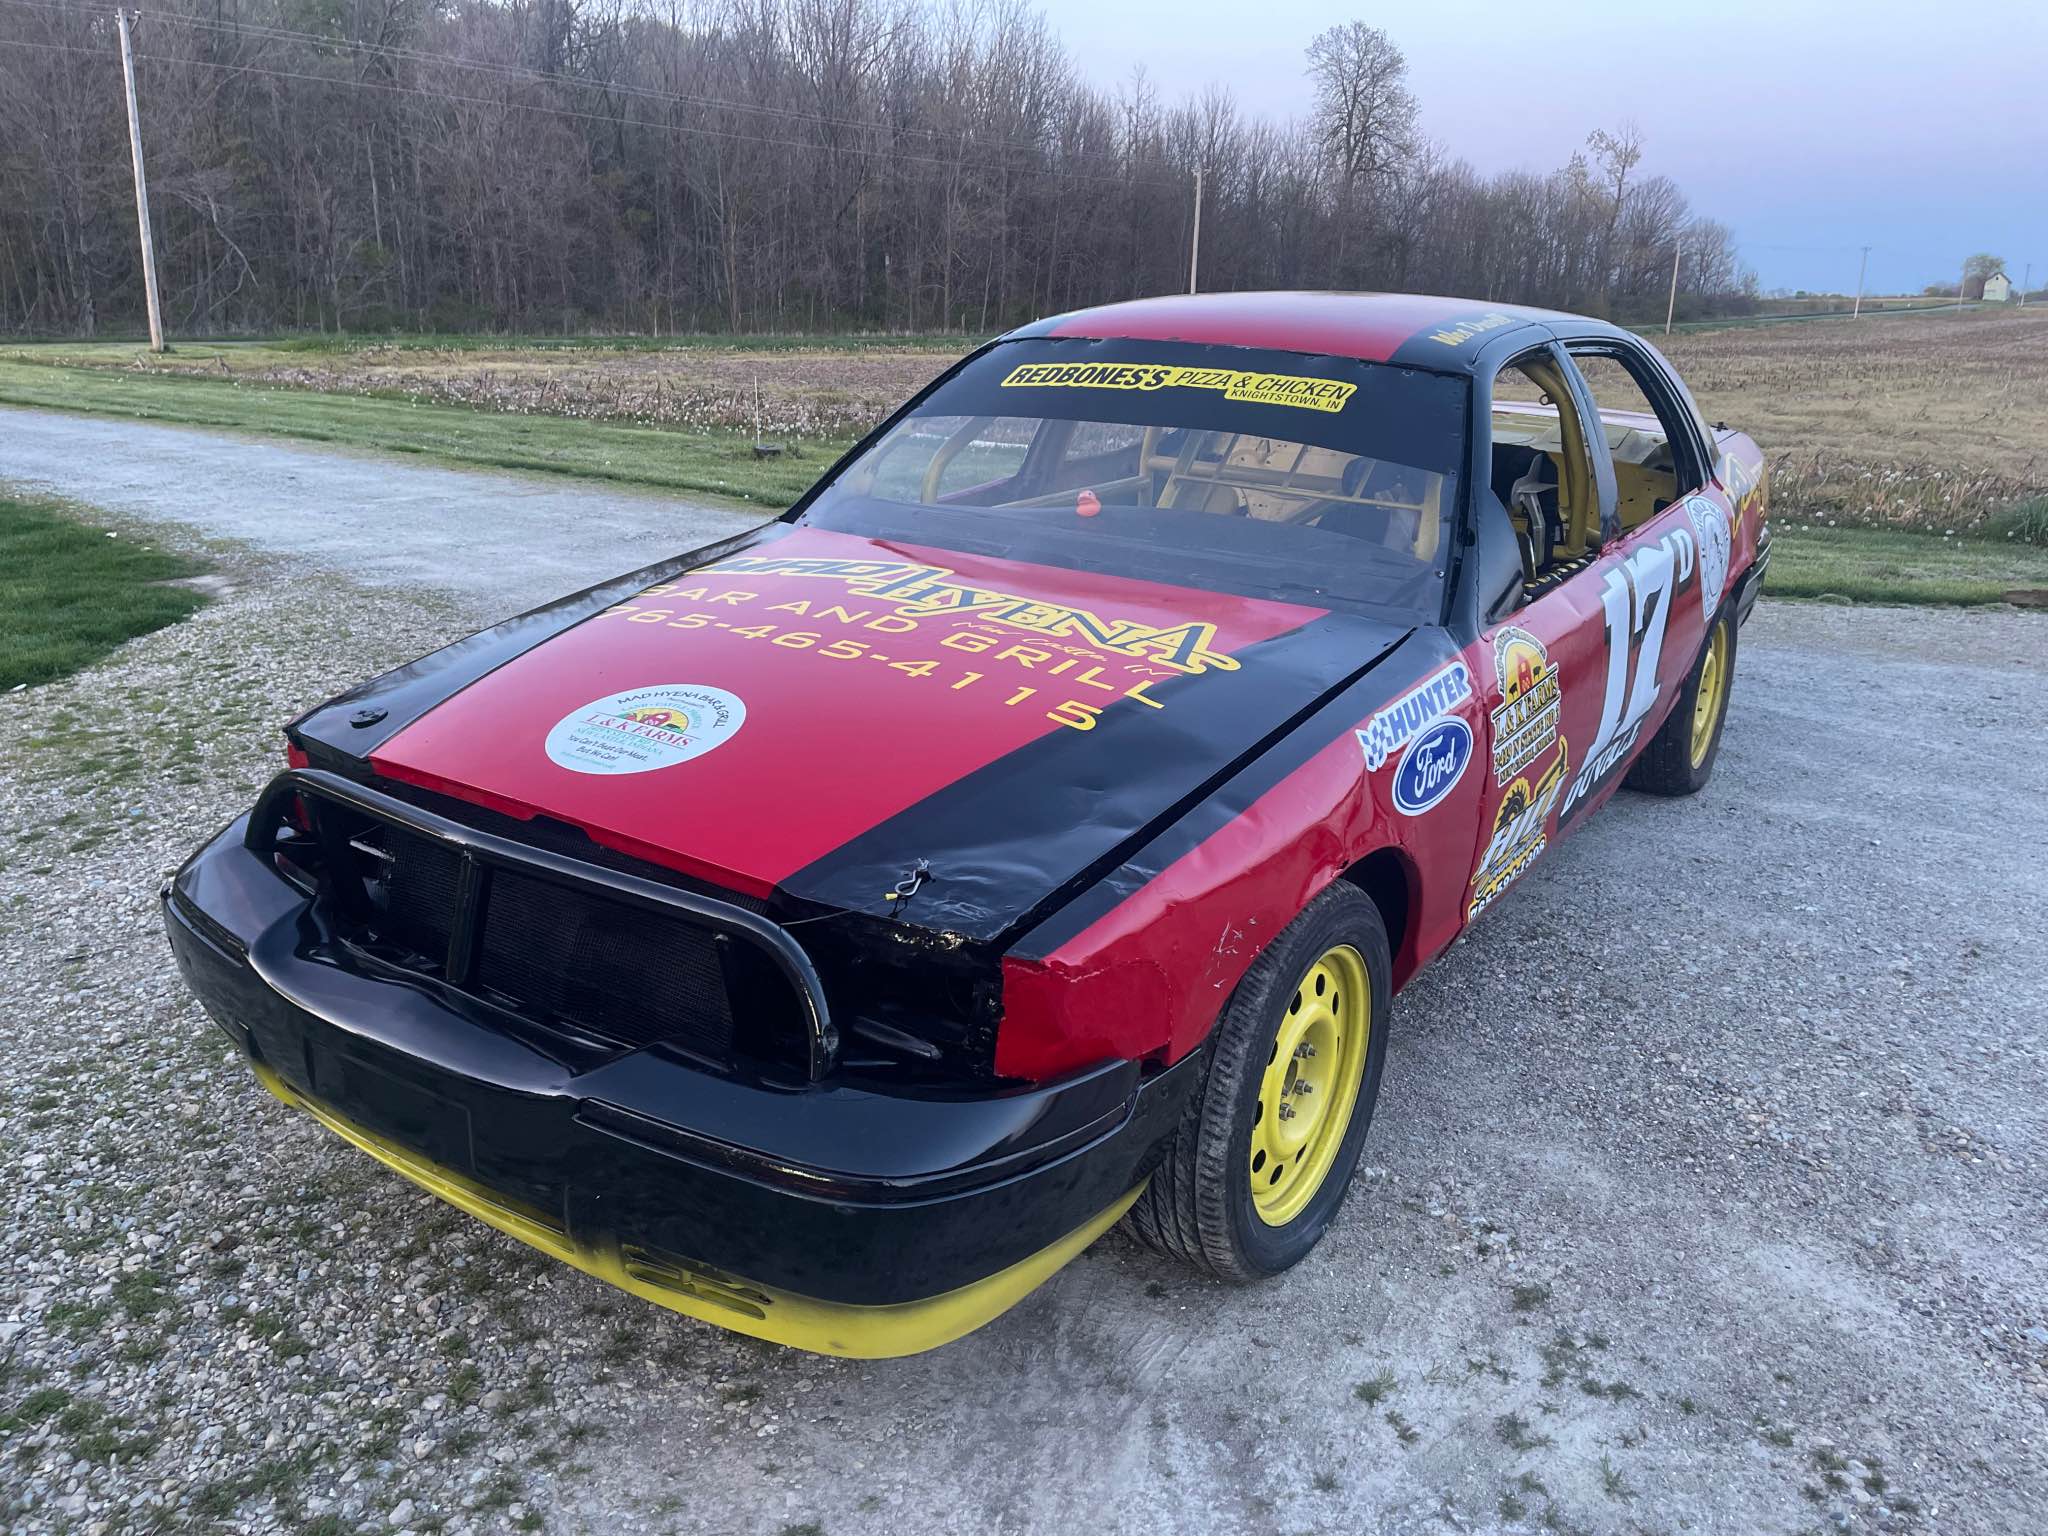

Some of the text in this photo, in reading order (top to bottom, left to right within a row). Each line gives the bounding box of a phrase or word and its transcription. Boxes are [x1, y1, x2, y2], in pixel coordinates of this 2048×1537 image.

[1007, 366, 1353, 400] REDBONES'S PIZZA & CHICKEN
[1231, 388, 1341, 410] KNIGHTSTOWN, IN
[845, 562, 1242, 676] HYENA
[593, 605, 1104, 732] 765-465-4115
[639, 584, 1166, 710] BAR AND GRILL
[1123, 664, 1184, 678] IN
[617, 692, 652, 705] MAD
[654, 690, 699, 698] HYENA
[1387, 667, 1470, 745] HUNTER
[600, 718, 615, 727] &
[631, 725, 690, 747] FARMS
[1414, 734, 1457, 798] Ford
